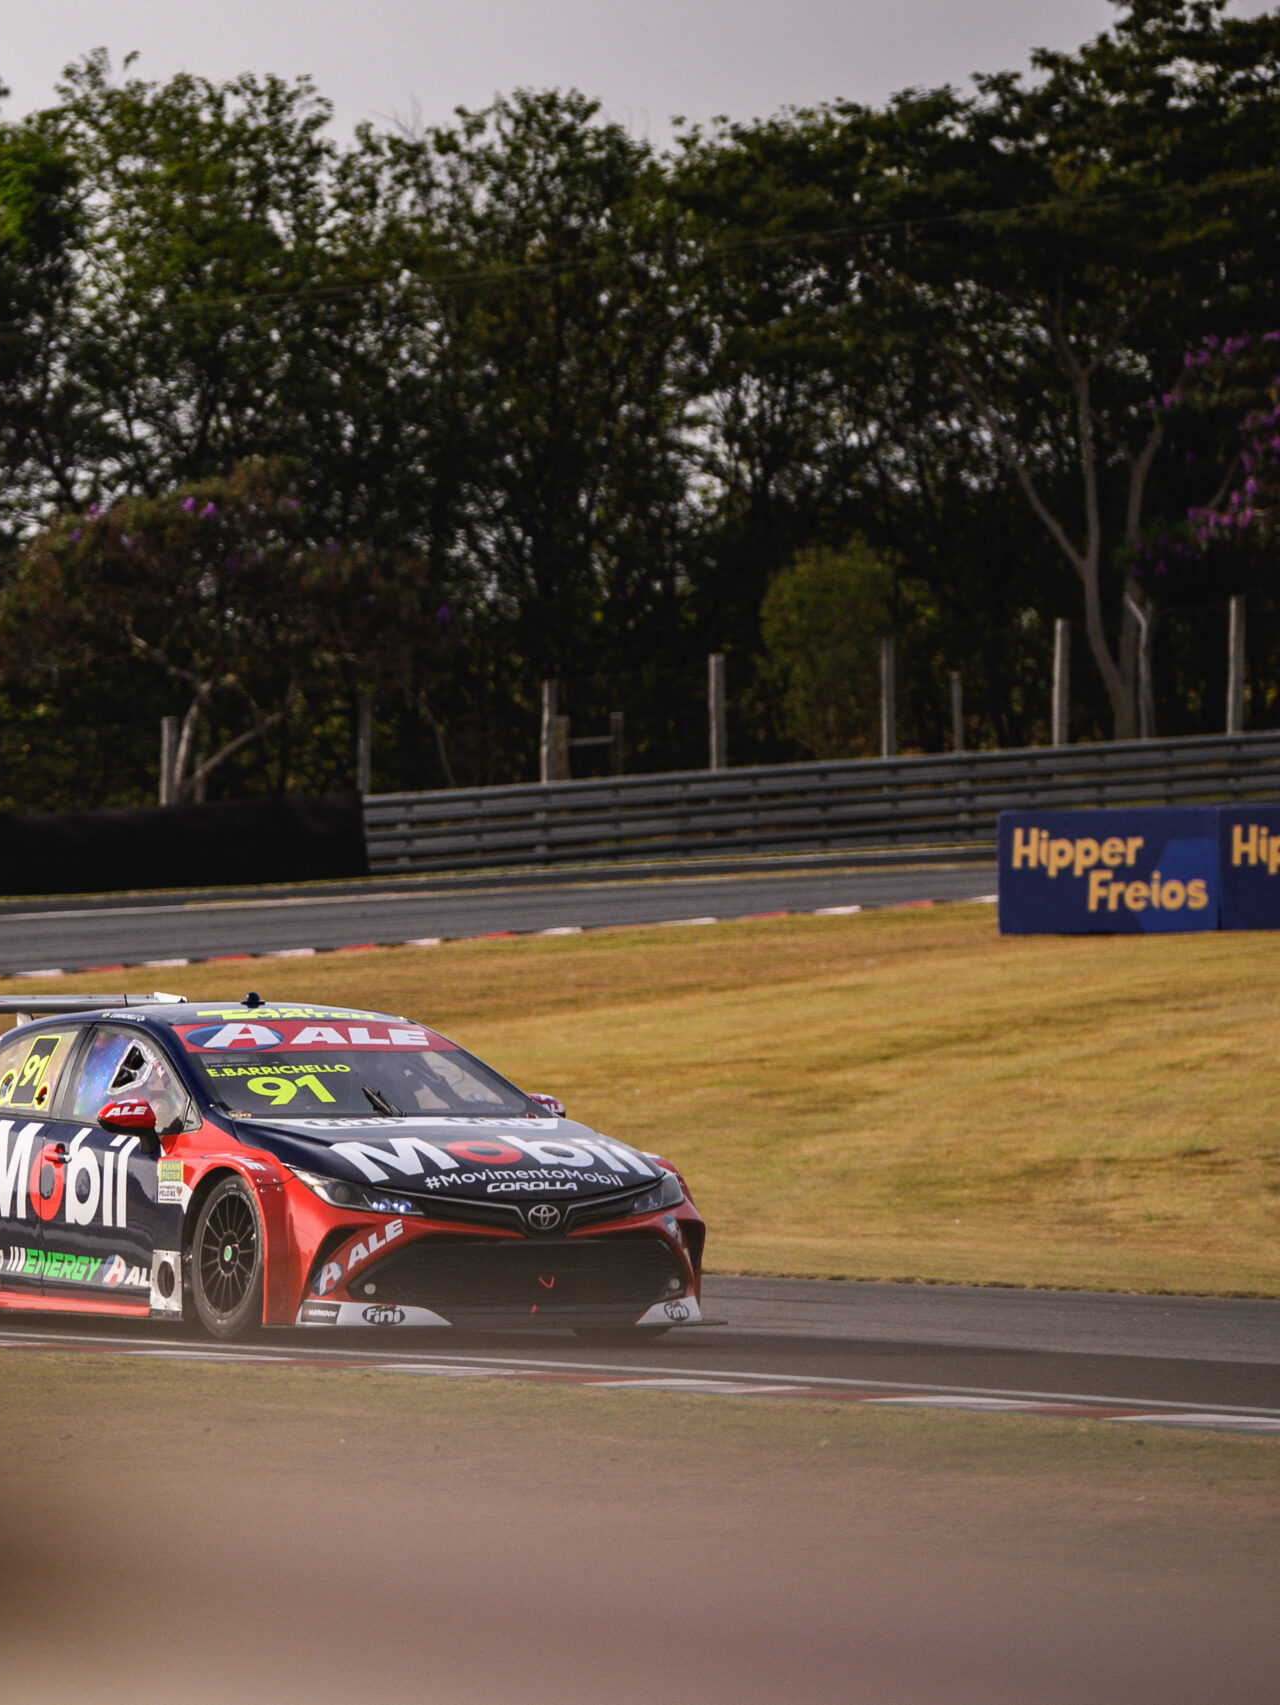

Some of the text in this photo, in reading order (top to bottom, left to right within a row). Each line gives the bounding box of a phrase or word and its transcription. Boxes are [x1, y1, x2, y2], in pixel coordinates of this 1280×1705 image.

[1012, 827, 1144, 877] Hipper
[1088, 869, 1210, 912] Freios
[290, 1026, 430, 1046] ALE
[19, 1054, 51, 1087] 91
[206, 1064, 351, 1078] E.BARRICHELLO
[247, 1074, 337, 1106] 91
[105, 1106, 148, 1118] ALE
[329, 1135, 657, 1183] Mobil
[425, 1168, 624, 1189] #MovimentoMobil
[486, 1182, 578, 1193] COROLLA
[347, 1218, 404, 1270] ALE
[23, 1249, 102, 1282] ENERGY
[124, 1266, 152, 1287] AL
[365, 1306, 402, 1323] Fini
